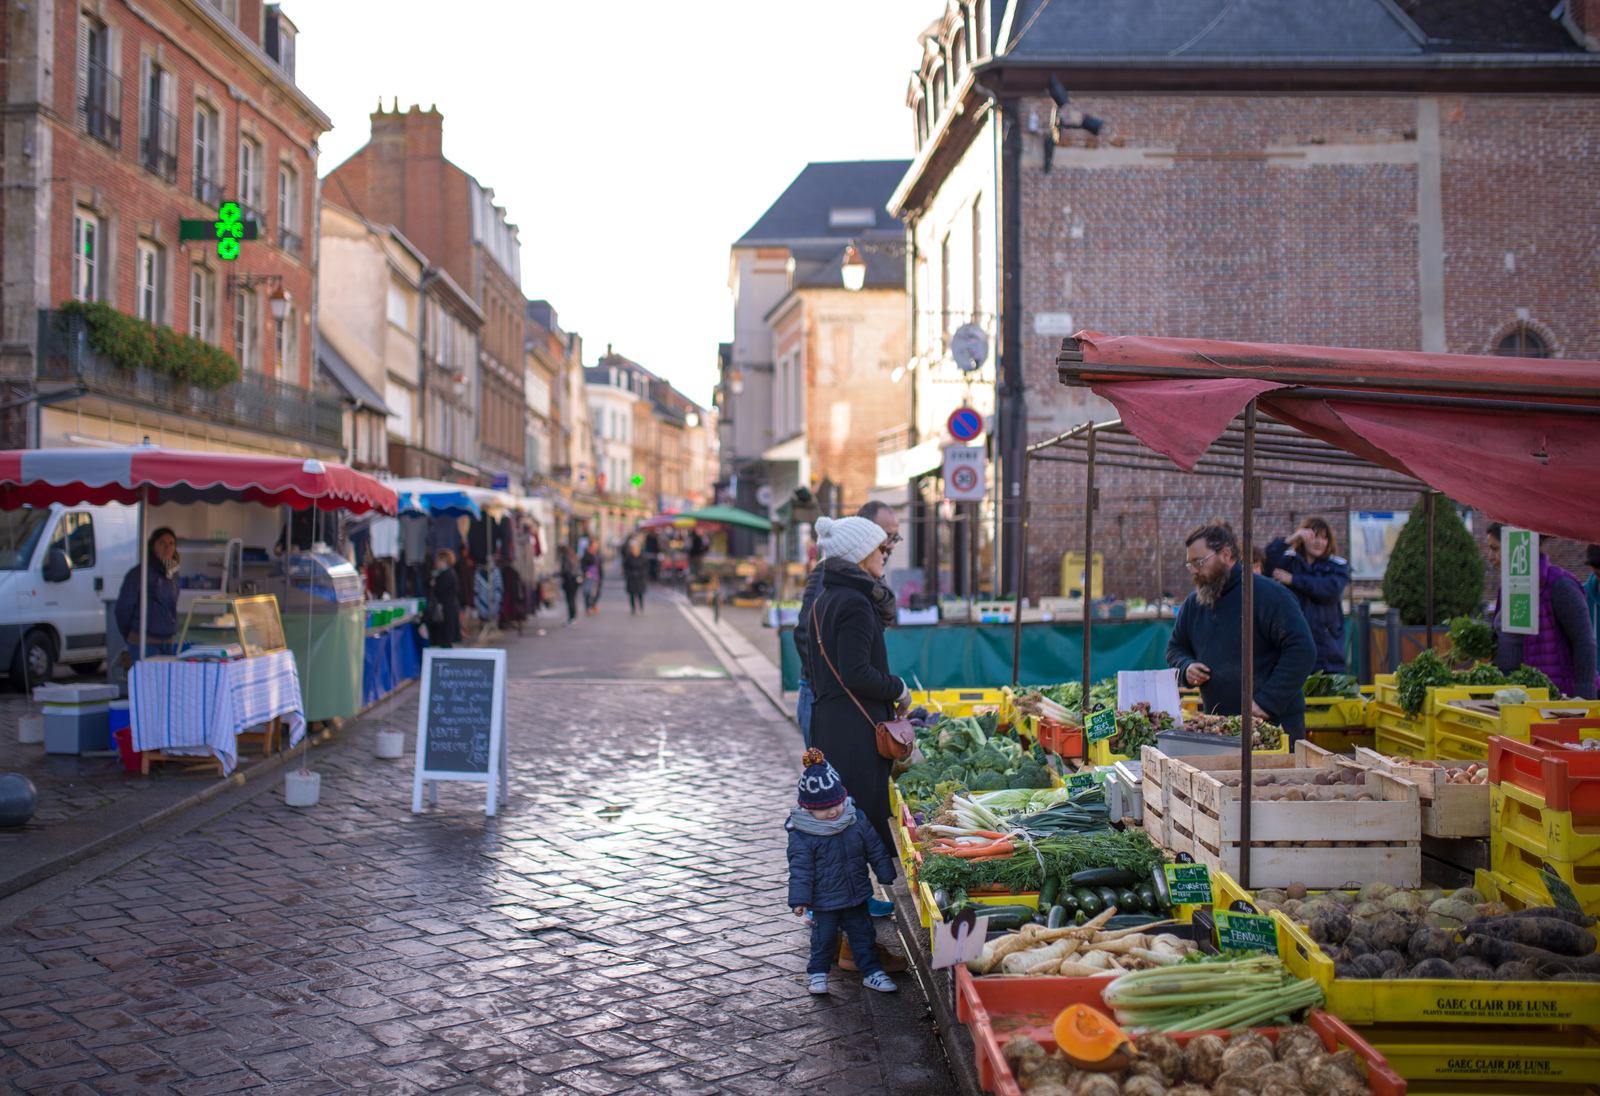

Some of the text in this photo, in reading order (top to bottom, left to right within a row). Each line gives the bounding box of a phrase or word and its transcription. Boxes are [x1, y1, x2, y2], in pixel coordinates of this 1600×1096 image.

[1510, 545, 1528, 575] AB
[1437, 998, 1558, 1011] GAEC CLAIR DE LUNE
[1447, 1059, 1551, 1070] GAEC CLAIR DE LUNE
